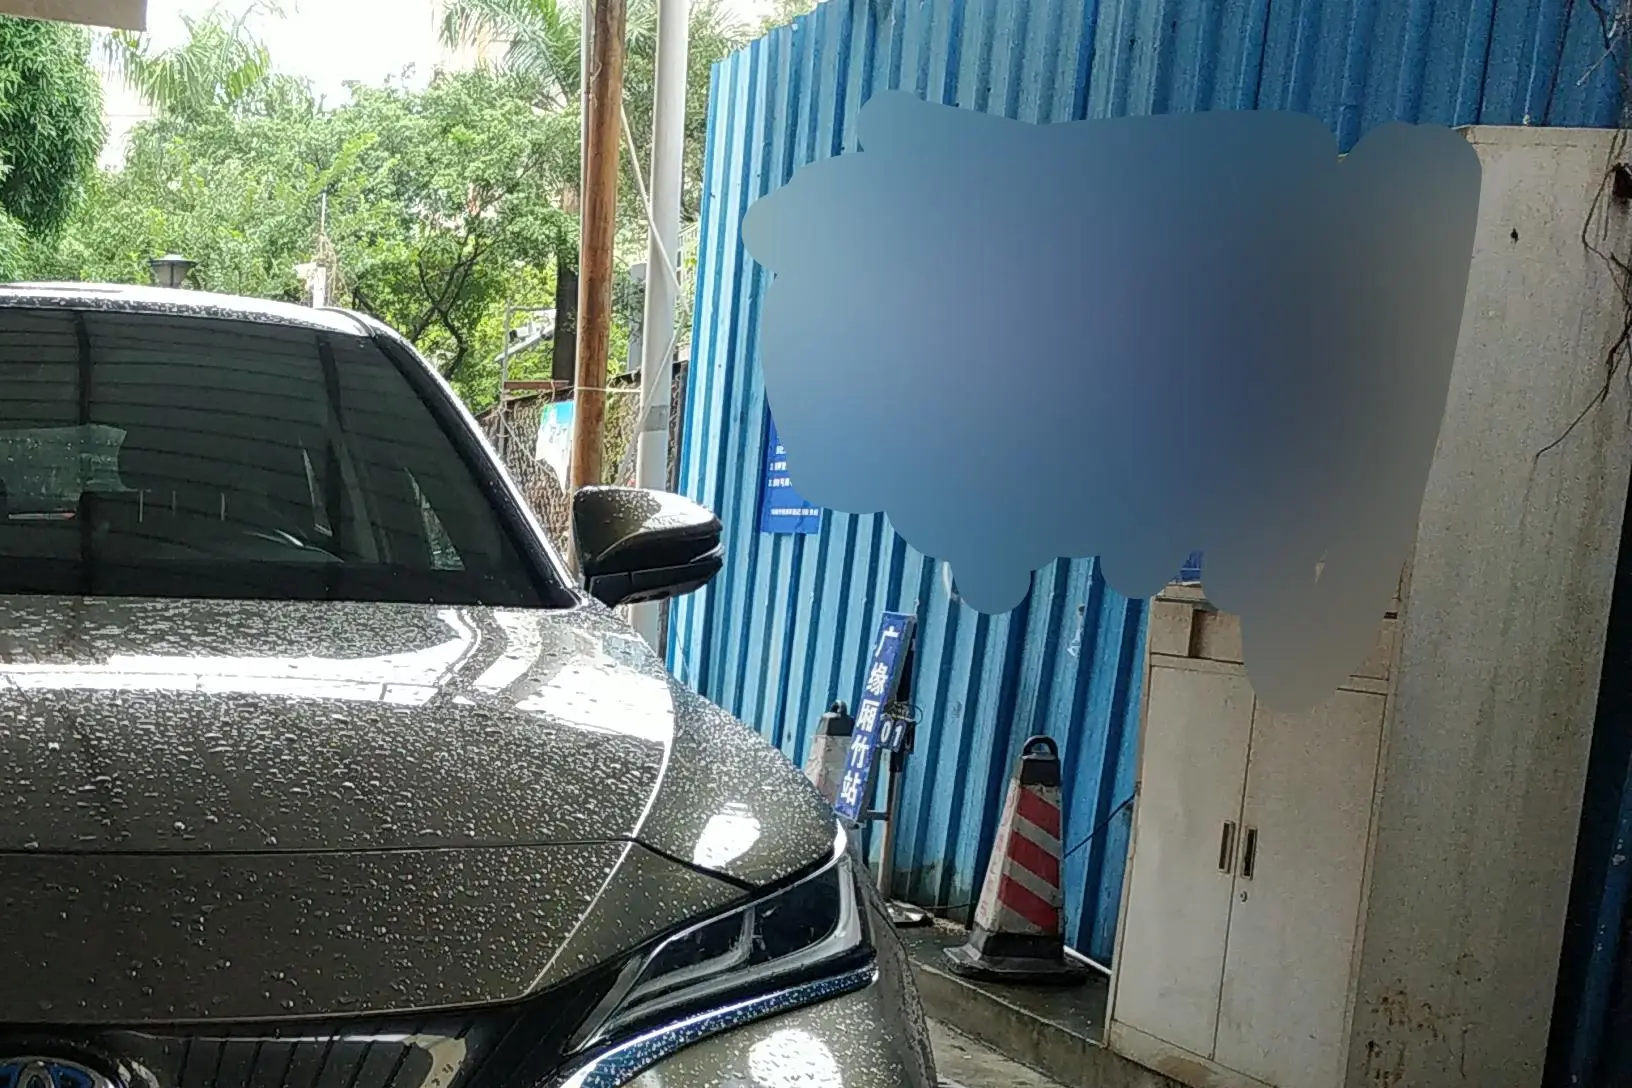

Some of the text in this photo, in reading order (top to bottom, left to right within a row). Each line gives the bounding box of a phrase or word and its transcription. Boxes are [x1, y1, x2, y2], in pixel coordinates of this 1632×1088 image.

[840, 625, 899, 806] 广缘厢竹站
[880, 719, 904, 748] 01
